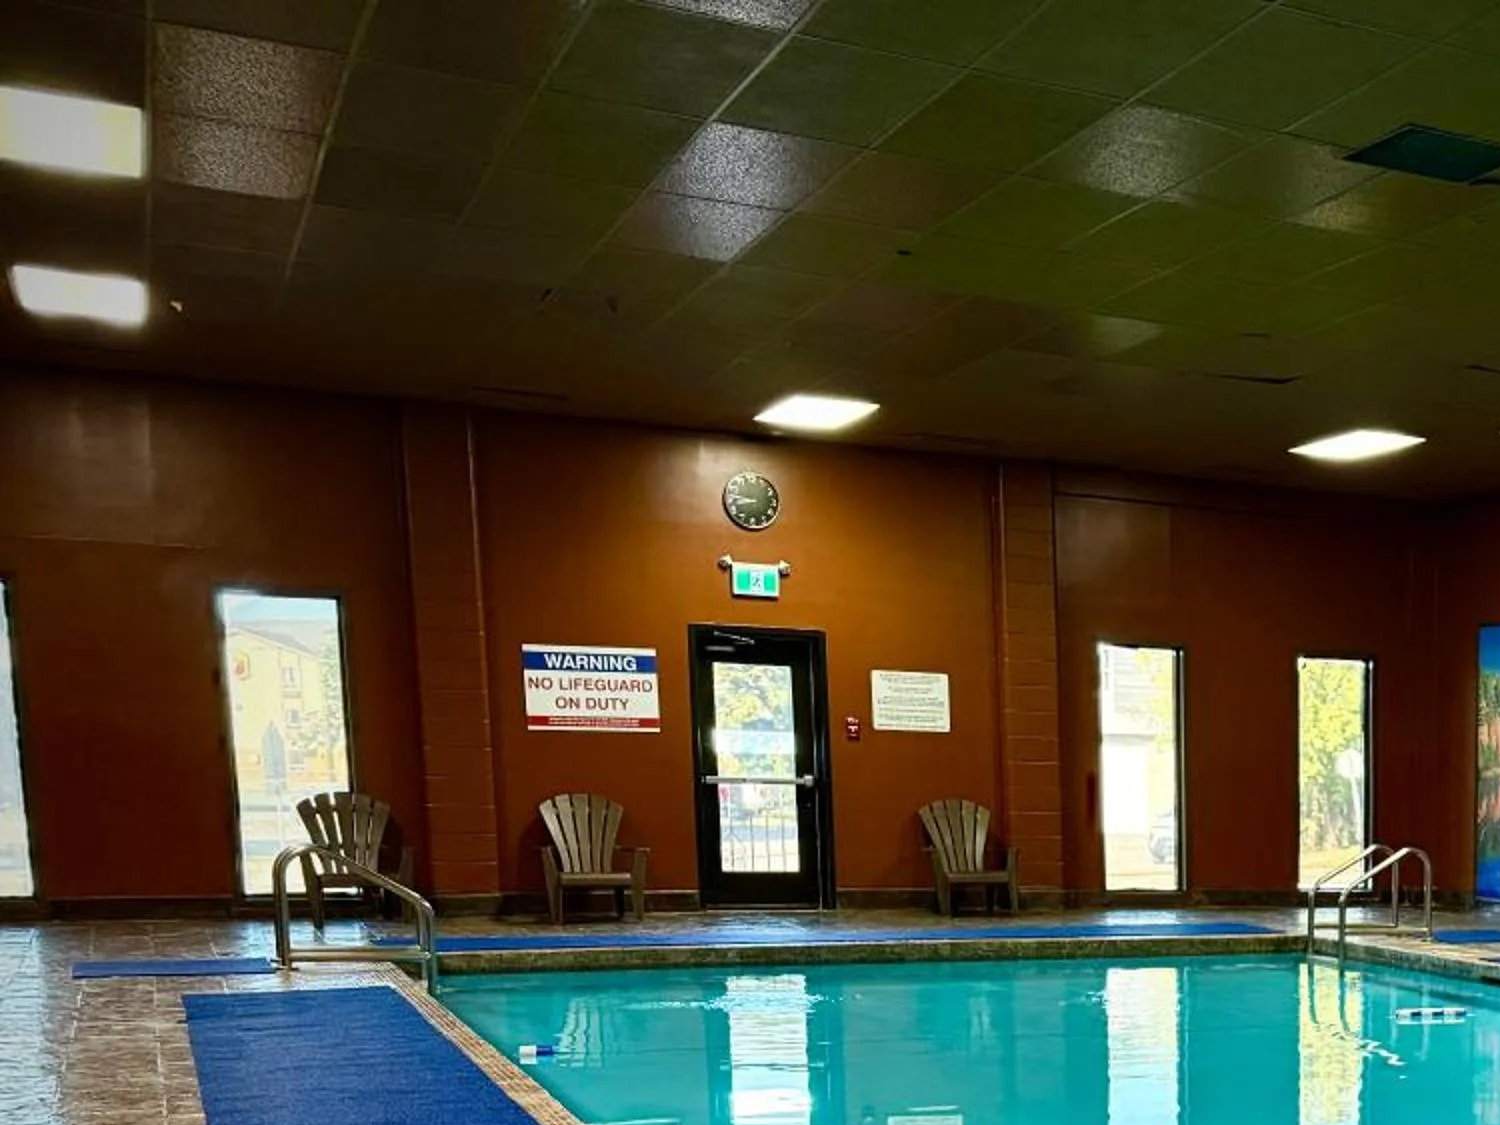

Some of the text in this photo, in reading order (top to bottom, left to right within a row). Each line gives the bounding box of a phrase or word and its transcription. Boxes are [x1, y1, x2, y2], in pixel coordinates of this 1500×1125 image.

[543, 653, 638, 671] WARNING
[528, 677, 653, 693] NO LIFEGUARD
[555, 696, 629, 711] ON DUTY
